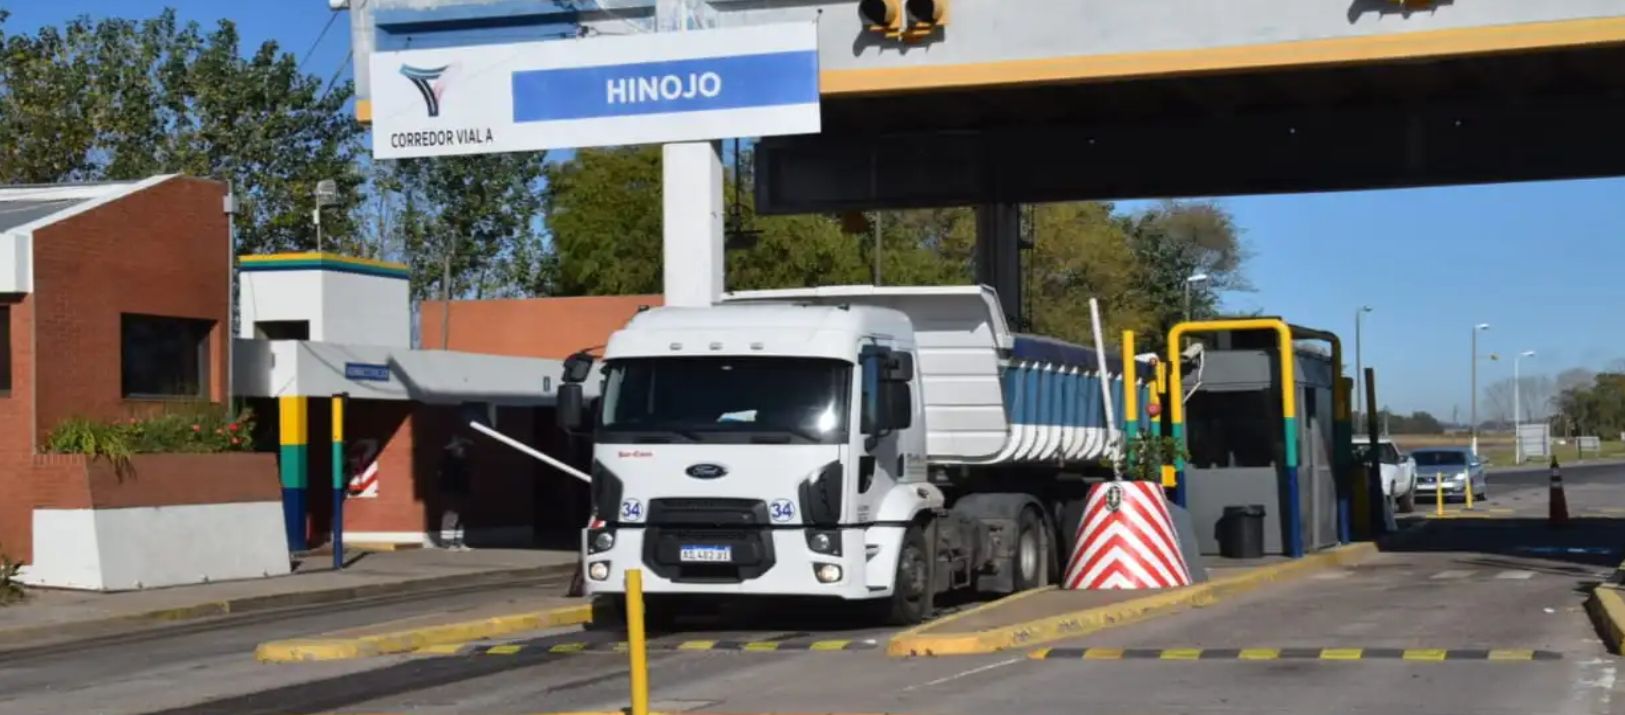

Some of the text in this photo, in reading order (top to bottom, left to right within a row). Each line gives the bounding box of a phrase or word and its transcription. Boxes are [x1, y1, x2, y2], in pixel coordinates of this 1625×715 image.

[607, 71, 721, 104] HINOJO
[391, 127, 494, 148] CORREDOR VIAL A
[690, 464, 721, 477] Ford
[622, 502, 641, 517] 34
[771, 502, 792, 518] 34
